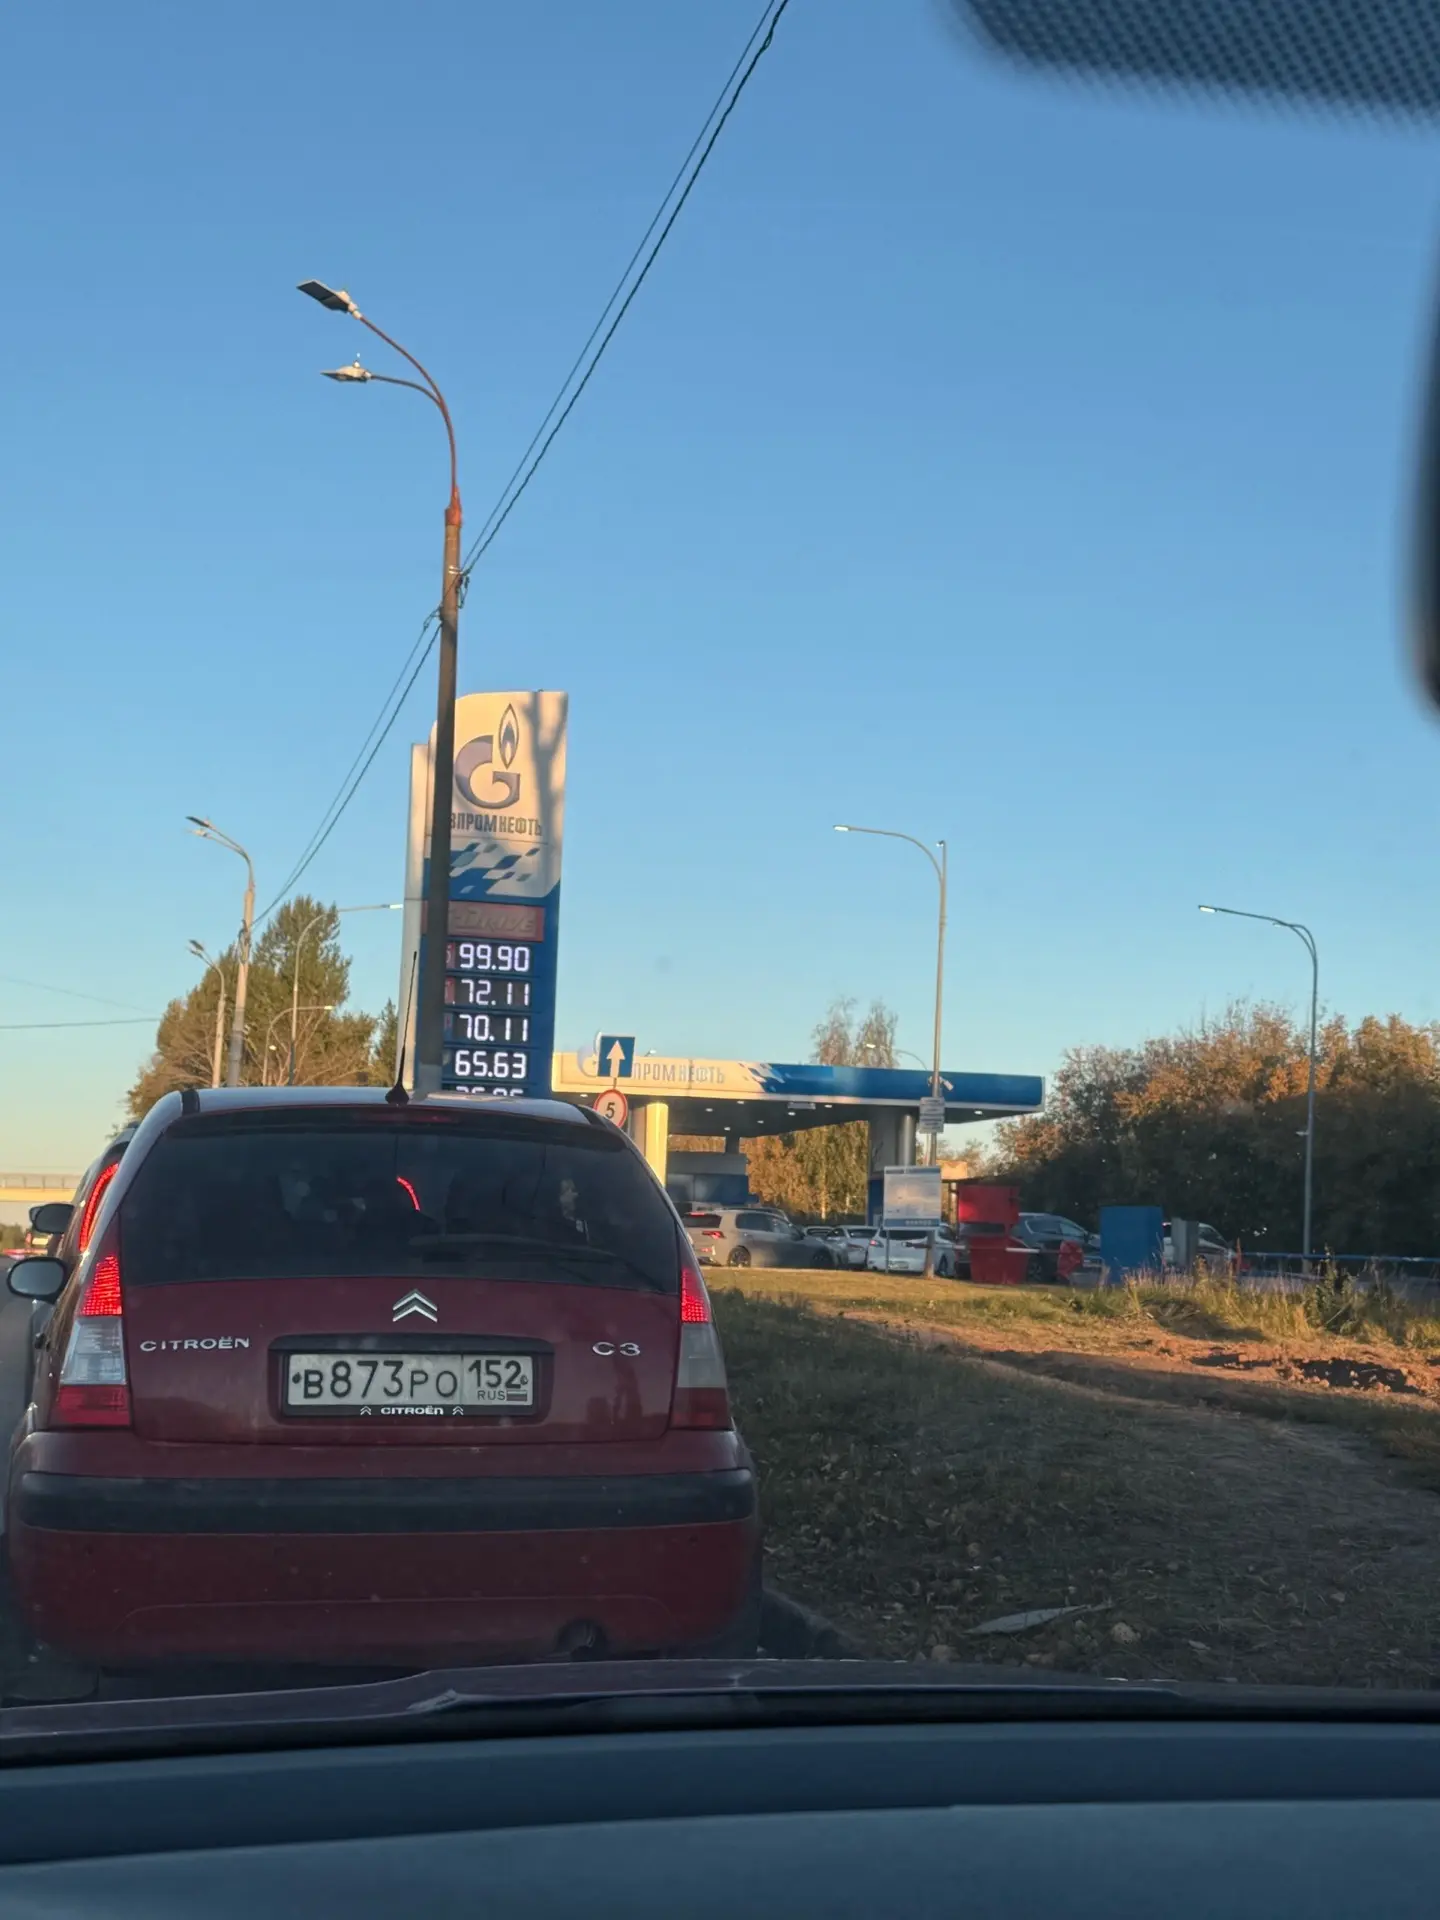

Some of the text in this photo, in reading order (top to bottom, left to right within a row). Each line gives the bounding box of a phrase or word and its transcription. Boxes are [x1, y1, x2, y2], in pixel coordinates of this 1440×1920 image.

[450, 812, 542, 837] ЗПРОМНЕФТЬ
[459, 942, 530, 972] 99.90
[461, 979, 530, 1006] 72.11
[459, 1014, 528, 1042] 70.11
[455, 1050, 527, 1078] 65.63
[633, 1062, 726, 1084] ПРОМНЕФТЬ
[605, 1102, 616, 1119] 5
[140, 1336, 250, 1352] CITROËN
[468, 1359, 522, 1389] 152
[477, 1390, 506, 1401] RUS
